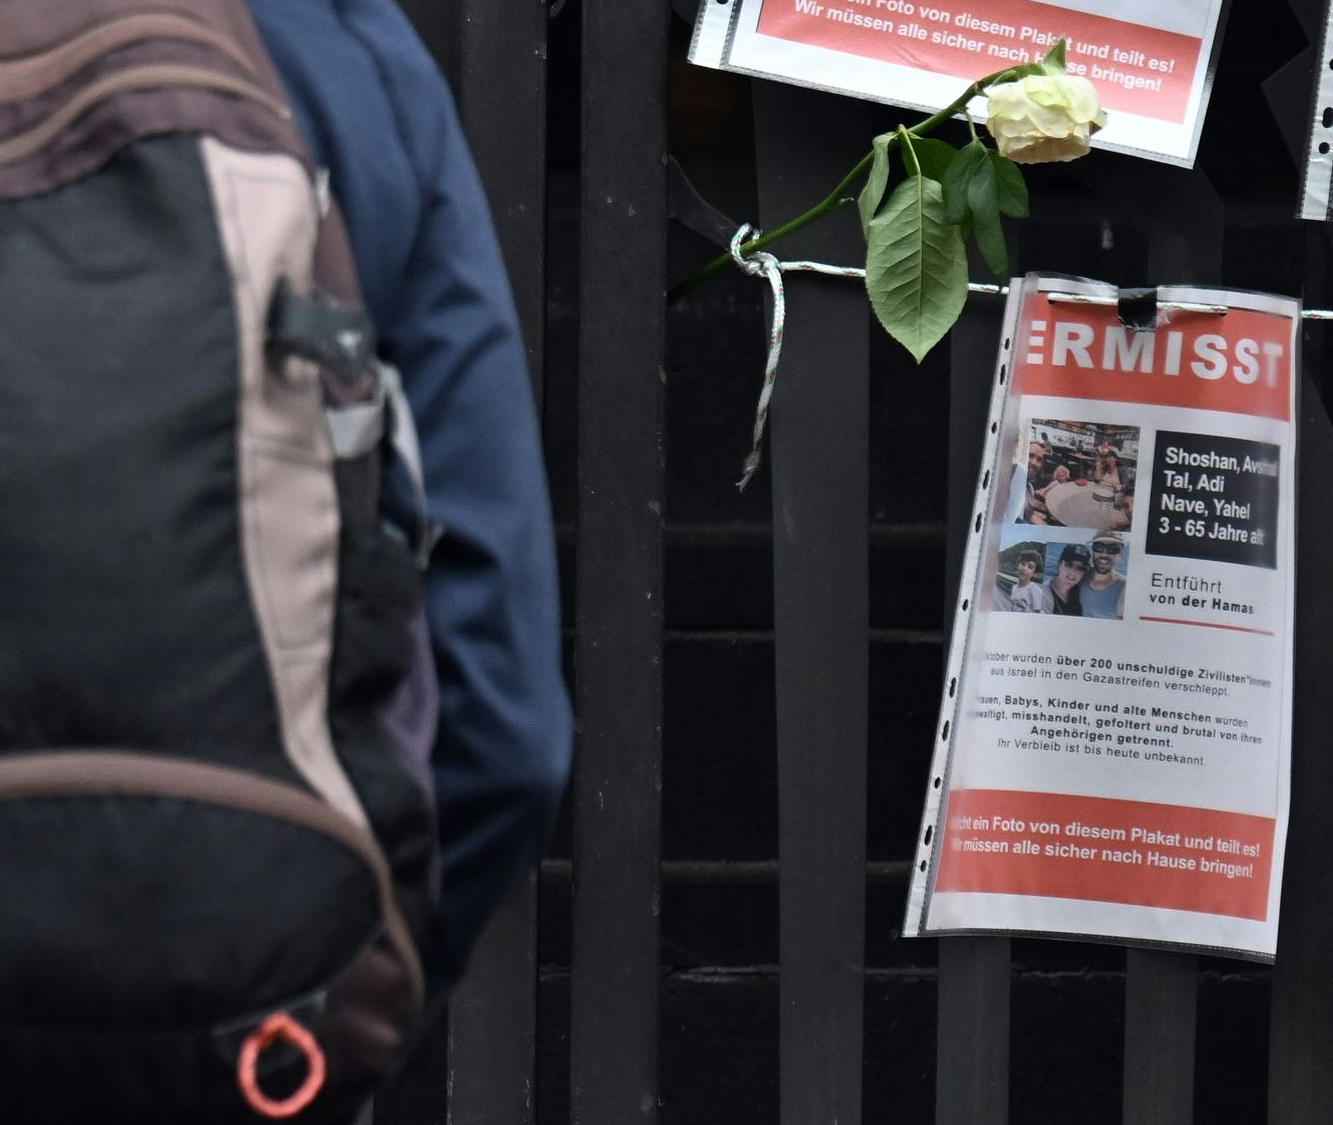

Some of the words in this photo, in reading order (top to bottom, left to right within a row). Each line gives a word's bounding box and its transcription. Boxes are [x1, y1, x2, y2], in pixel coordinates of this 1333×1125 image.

[1164, 446, 1241, 474] Shoshan,
[1163, 469, 1193, 492] Tal,
[1195, 473, 1225, 493] Adi
[1160, 492, 1209, 518] Nave,
[1212, 497, 1251, 520] Yahel
[1158, 516, 1170, 534] 3
[1184, 518, 1206, 538] 65
[1207, 521, 1249, 543] Jahre
[1150, 571, 1222, 594] Entführt
[1148, 593, 1176, 605] von
[1180, 594, 1207, 608] der
[1211, 597, 1254, 615] Hamas
